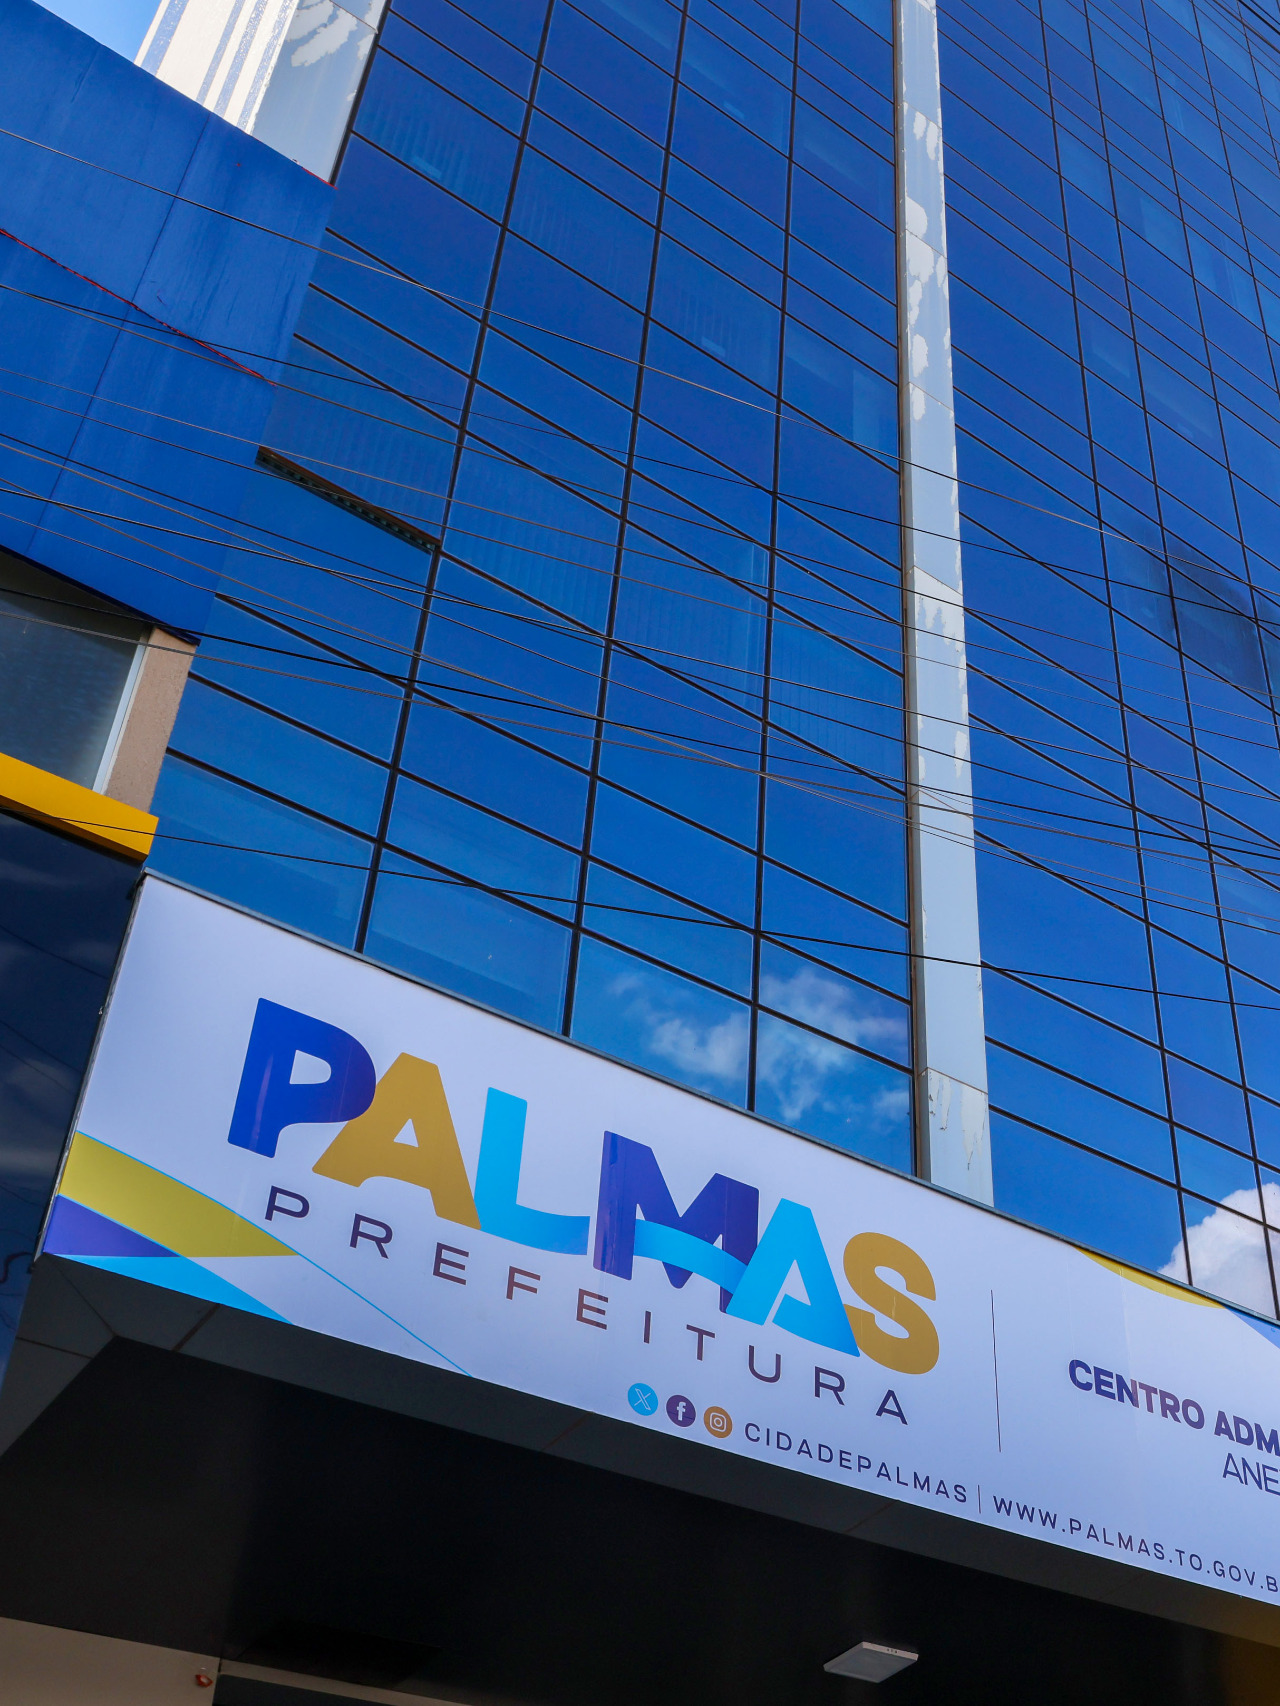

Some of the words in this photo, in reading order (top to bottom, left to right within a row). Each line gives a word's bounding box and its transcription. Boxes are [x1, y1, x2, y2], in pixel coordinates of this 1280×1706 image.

[228, 997, 939, 1375] PALMAS
[264, 1185, 907, 1424] PREFEITURA
[745, 1423, 967, 1503] CIDADEPALMAS
[1069, 1359, 1205, 1430] CENTRO
